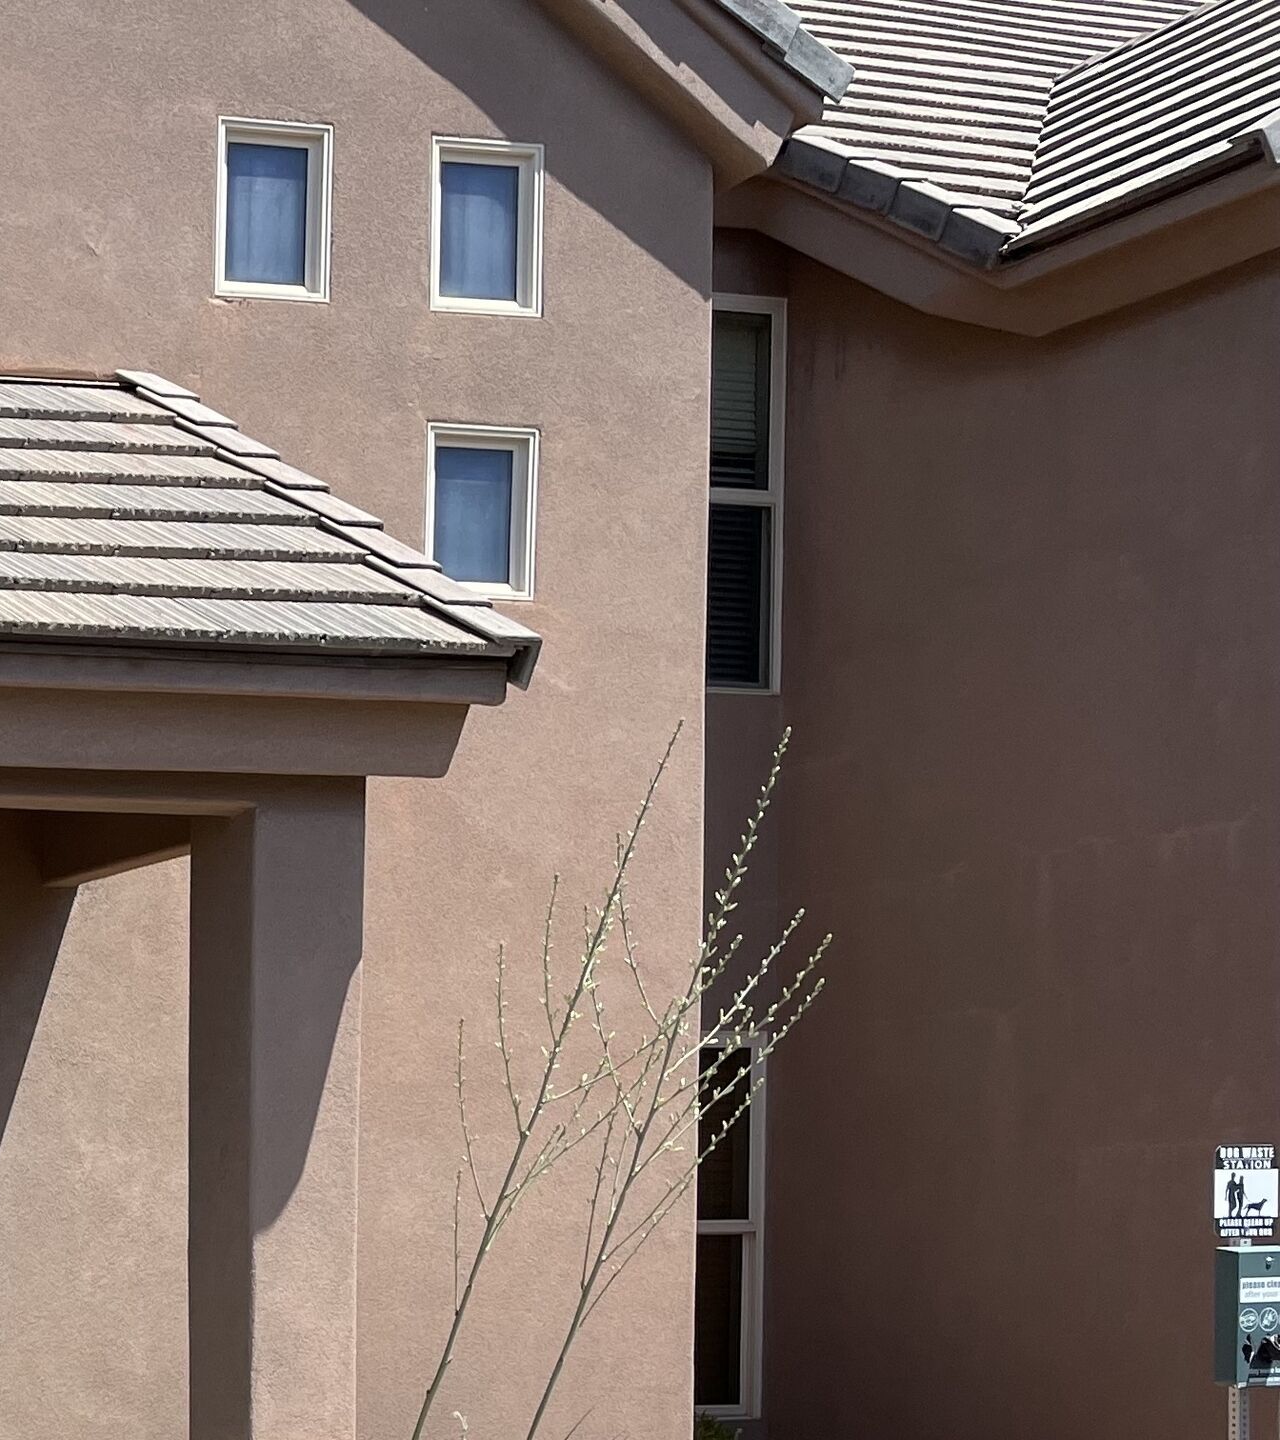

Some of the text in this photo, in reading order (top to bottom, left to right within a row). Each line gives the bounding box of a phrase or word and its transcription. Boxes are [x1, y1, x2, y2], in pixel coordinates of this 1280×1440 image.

[1241, 1147, 1275, 1158] WASTE
[1264, 1218, 1274, 1226] UP
[1242, 1281, 1265, 1289] please
